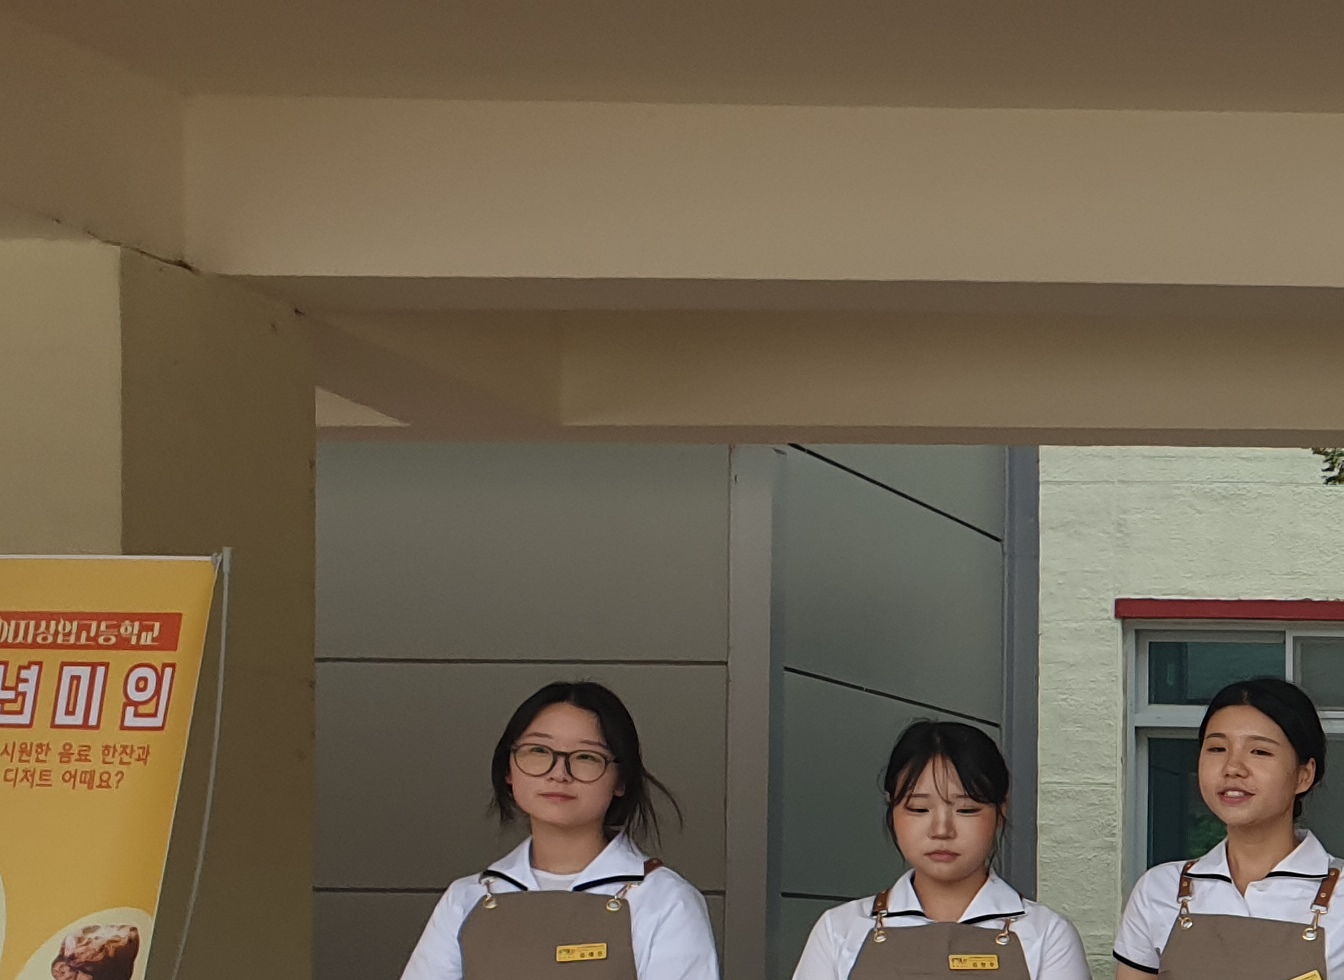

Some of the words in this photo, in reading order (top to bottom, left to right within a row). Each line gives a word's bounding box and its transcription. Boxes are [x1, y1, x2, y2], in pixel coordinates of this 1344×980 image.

[0, 741, 52, 764] 시원한
[58, 742, 92, 764] 음료
[101, 743, 151, 766] 한잔과
[4, 767, 53, 789] 디저트
[61, 769, 125, 790] 어때요?
